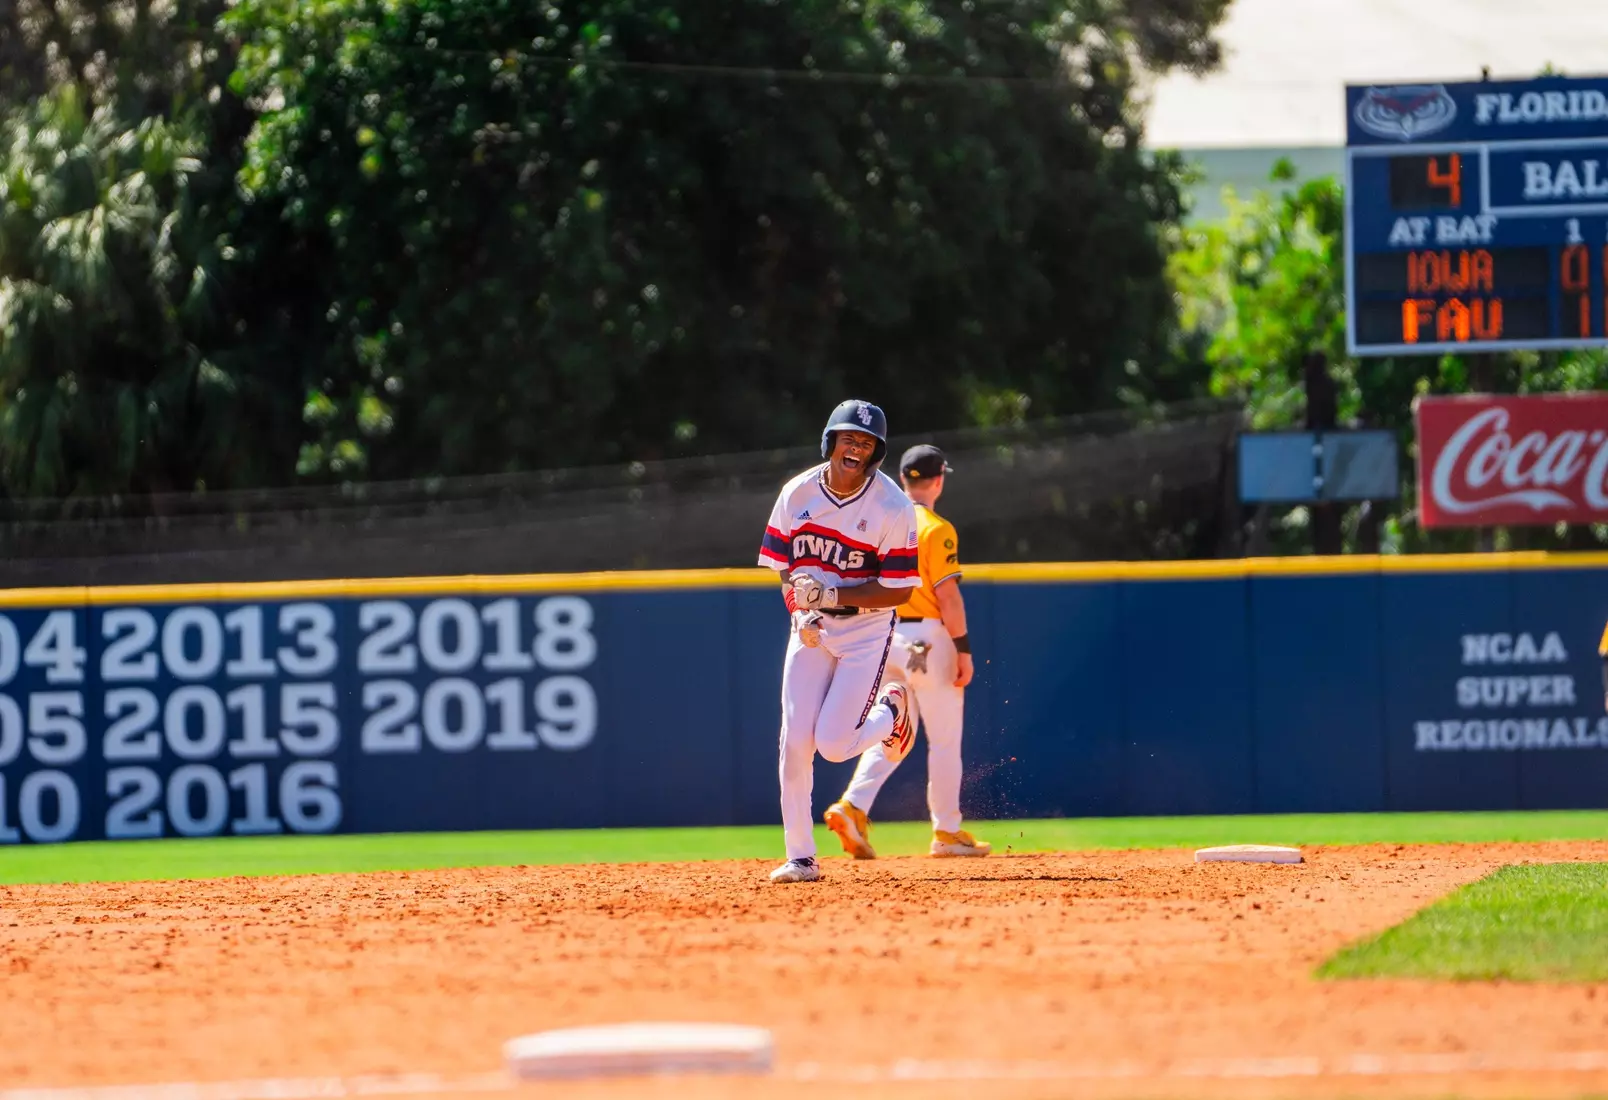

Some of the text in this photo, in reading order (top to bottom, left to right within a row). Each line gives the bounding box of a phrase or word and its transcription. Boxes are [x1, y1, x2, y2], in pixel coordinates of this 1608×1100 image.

[1475, 91, 1608, 125] FLORID
[1427, 153, 1461, 208] 4
[1523, 160, 1608, 199] BAL
[1389, 215, 1497, 246] AT BAT
[1565, 218, 1584, 243] 1
[1406, 249, 1494, 294] IOWA
[1402, 293, 1591, 344] FAU 1
[793, 535, 865, 570] OWLS
[100, 602, 339, 682] 2013
[357, 595, 597, 674] 2018
[1461, 631, 1567, 665] NCAA
[1456, 674, 1576, 708] SUPER
[102, 681, 341, 762] 2015
[361, 675, 598, 753] 2019
[104, 760, 343, 839] 2016
